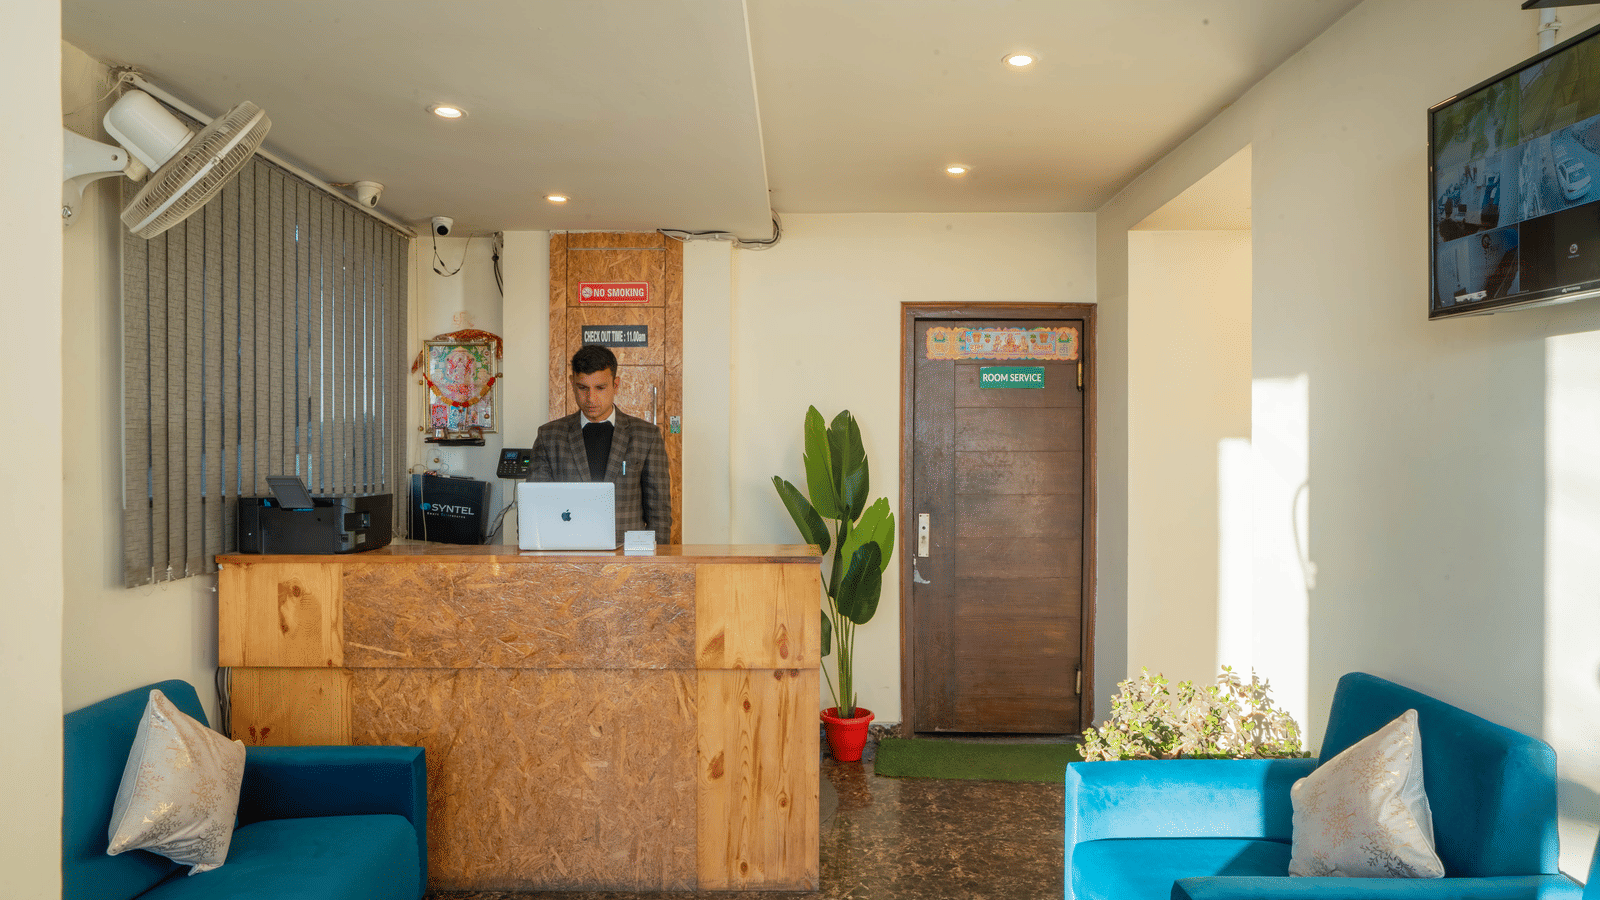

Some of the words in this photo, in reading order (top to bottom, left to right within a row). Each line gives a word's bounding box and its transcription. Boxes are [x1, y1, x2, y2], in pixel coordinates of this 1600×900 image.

[593, 288, 605, 297] NO
[607, 288, 645, 297] SMOKING
[584, 330, 600, 342] CHECK
[601, 330, 611, 342] OUT
[612, 330, 623, 342] TIME
[627, 331, 646, 342] 11.00am
[982, 373, 1008, 382] ROOM
[1010, 373, 1042, 382] SERVICE
[432, 503, 475, 515] SYNTEL
